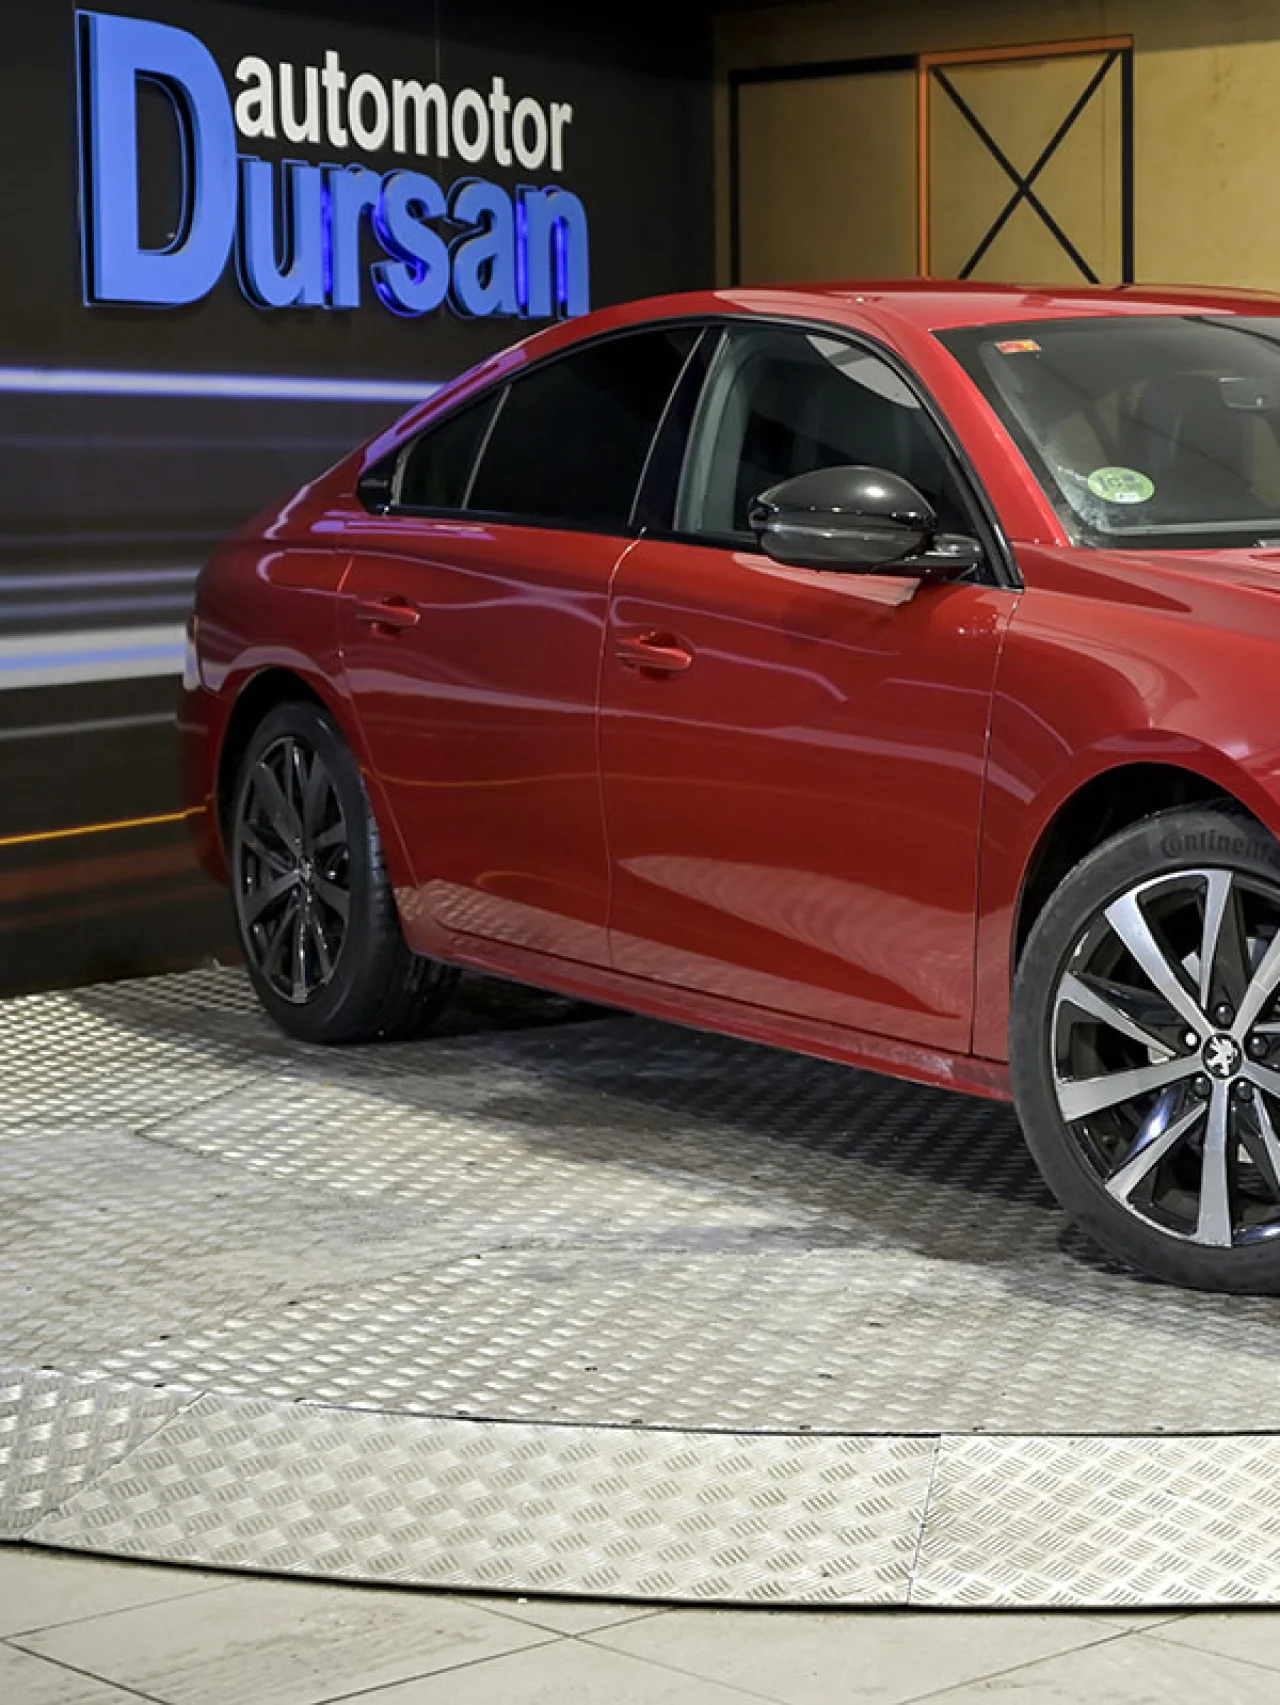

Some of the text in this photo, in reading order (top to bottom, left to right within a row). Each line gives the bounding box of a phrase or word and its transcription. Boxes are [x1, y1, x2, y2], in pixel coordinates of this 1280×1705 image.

[75, 9, 591, 319] Dursan
[236, 50, 573, 171] automotor
[1162, 829, 1280, 868] Continent
